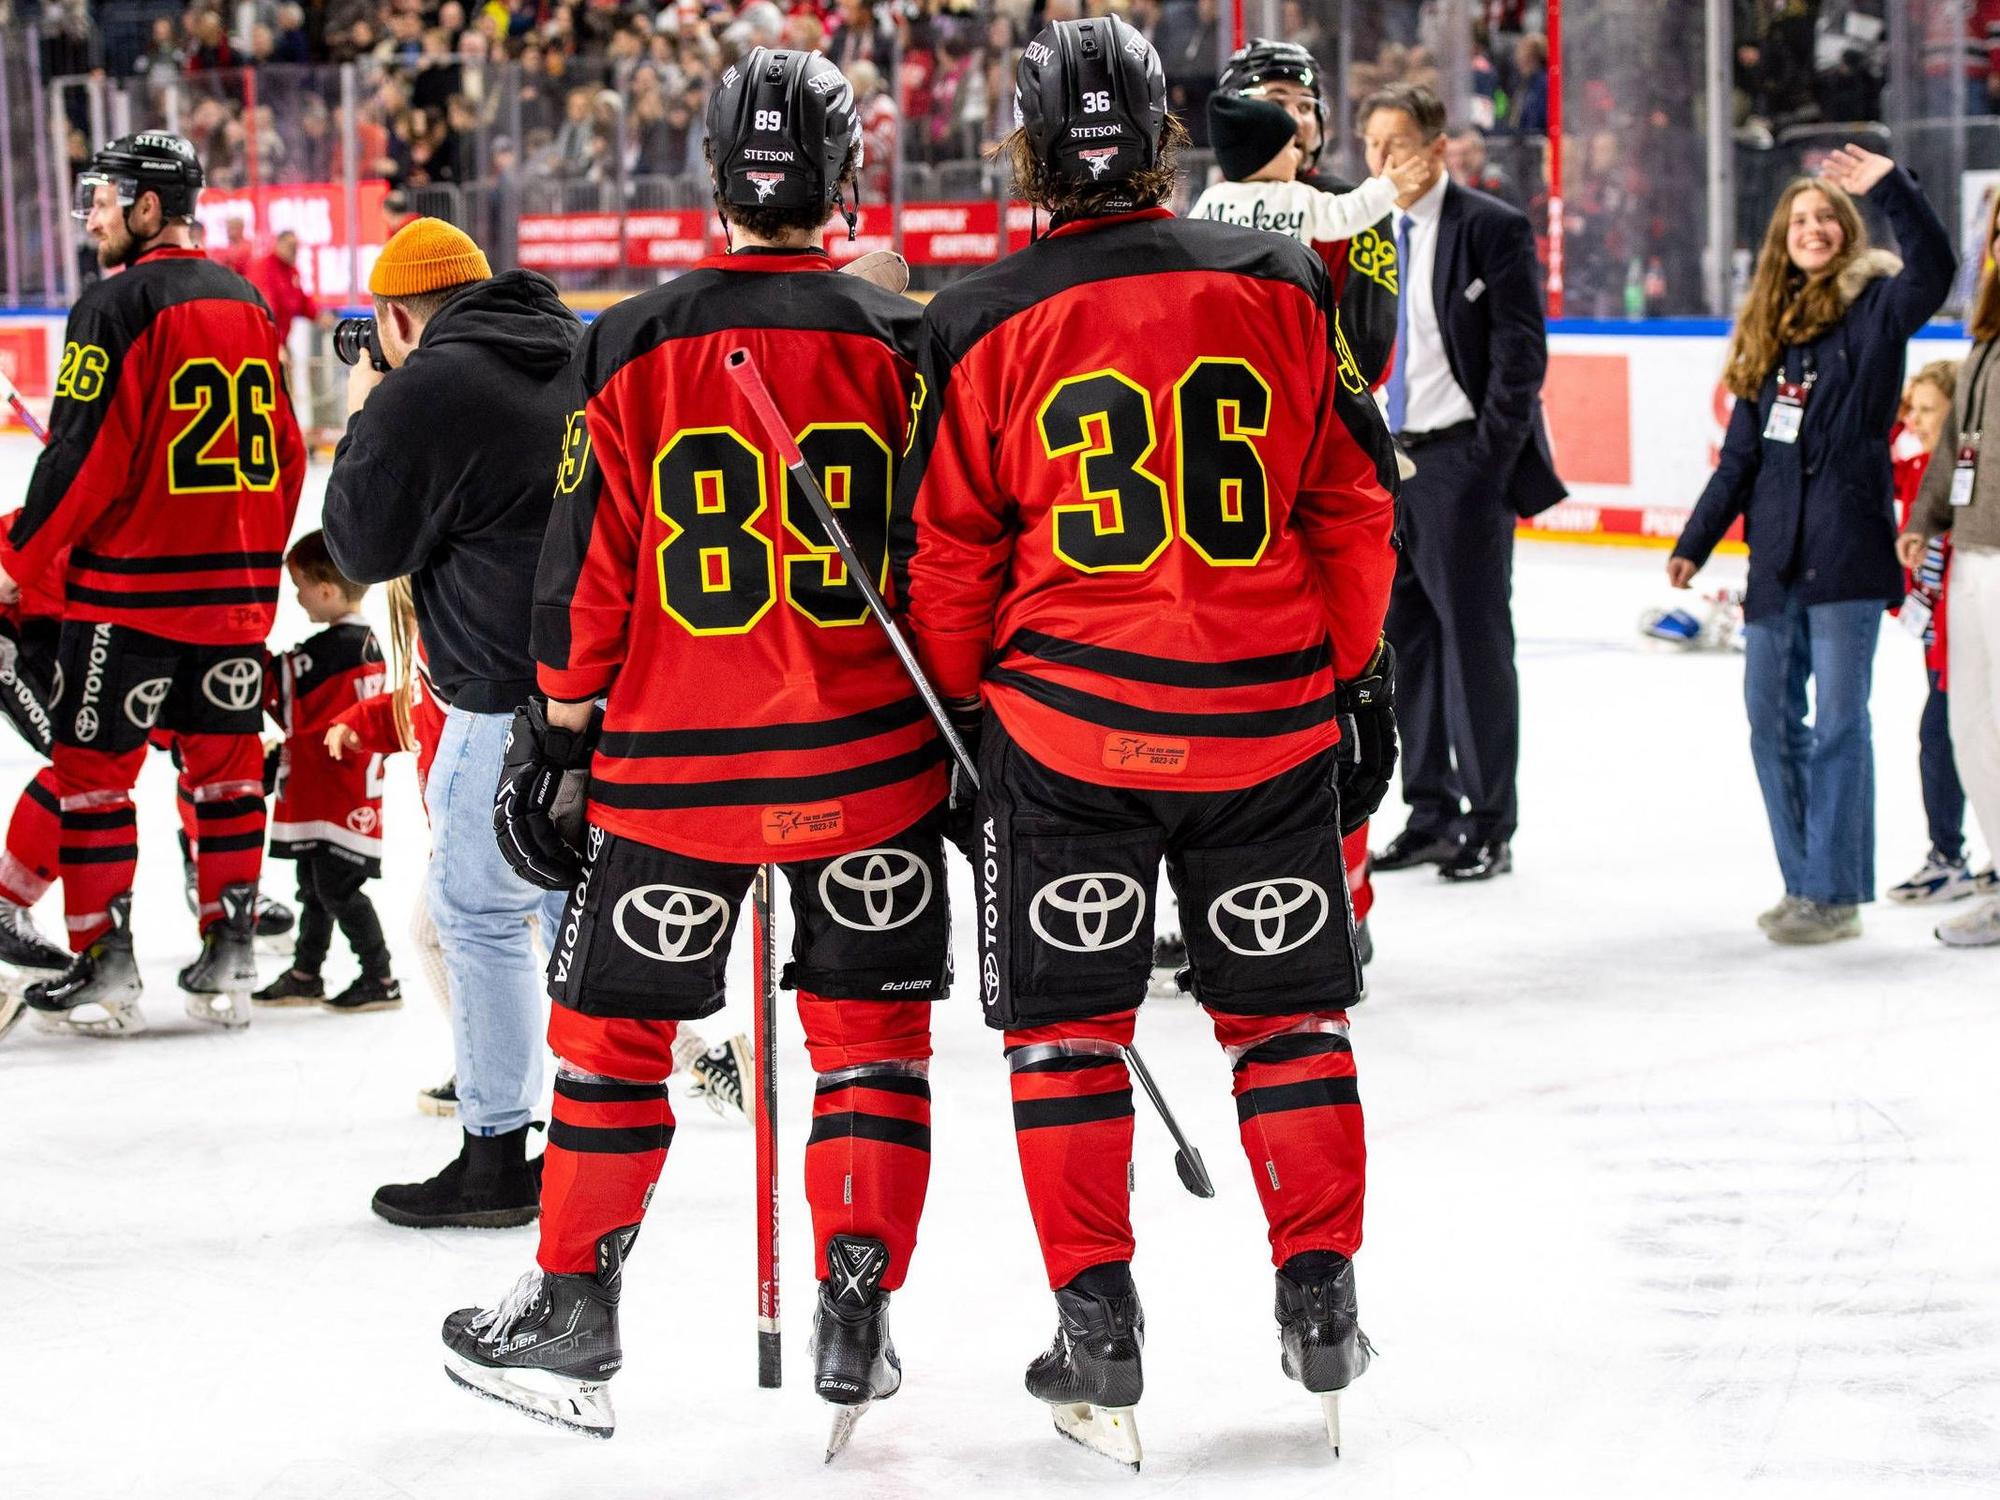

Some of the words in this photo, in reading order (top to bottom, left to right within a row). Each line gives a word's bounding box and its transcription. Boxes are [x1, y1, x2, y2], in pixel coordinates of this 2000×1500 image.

[1083, 90, 1110, 113] 36
[754, 109, 782, 132] 89
[1071, 123, 1122, 138] STETSON
[744, 149, 795, 162] STETSON
[1201, 199, 1305, 233] Mickey
[55, 341, 109, 402] 26
[168, 357, 280, 495] 26
[1036, 355, 1272, 575] 36
[652, 421, 893, 637] 89
[83, 622, 112, 705] TOYOTA
[14, 677, 51, 745] TOYOTA
[537, 771, 552, 806] BAUER
[984, 816, 998, 948] TOYOTA
[554, 866, 593, 984] TOYOTA
[881, 979, 932, 991] BAUER
[599, 1359, 623, 1372] BAU
[819, 1380, 859, 1392] BAUER
